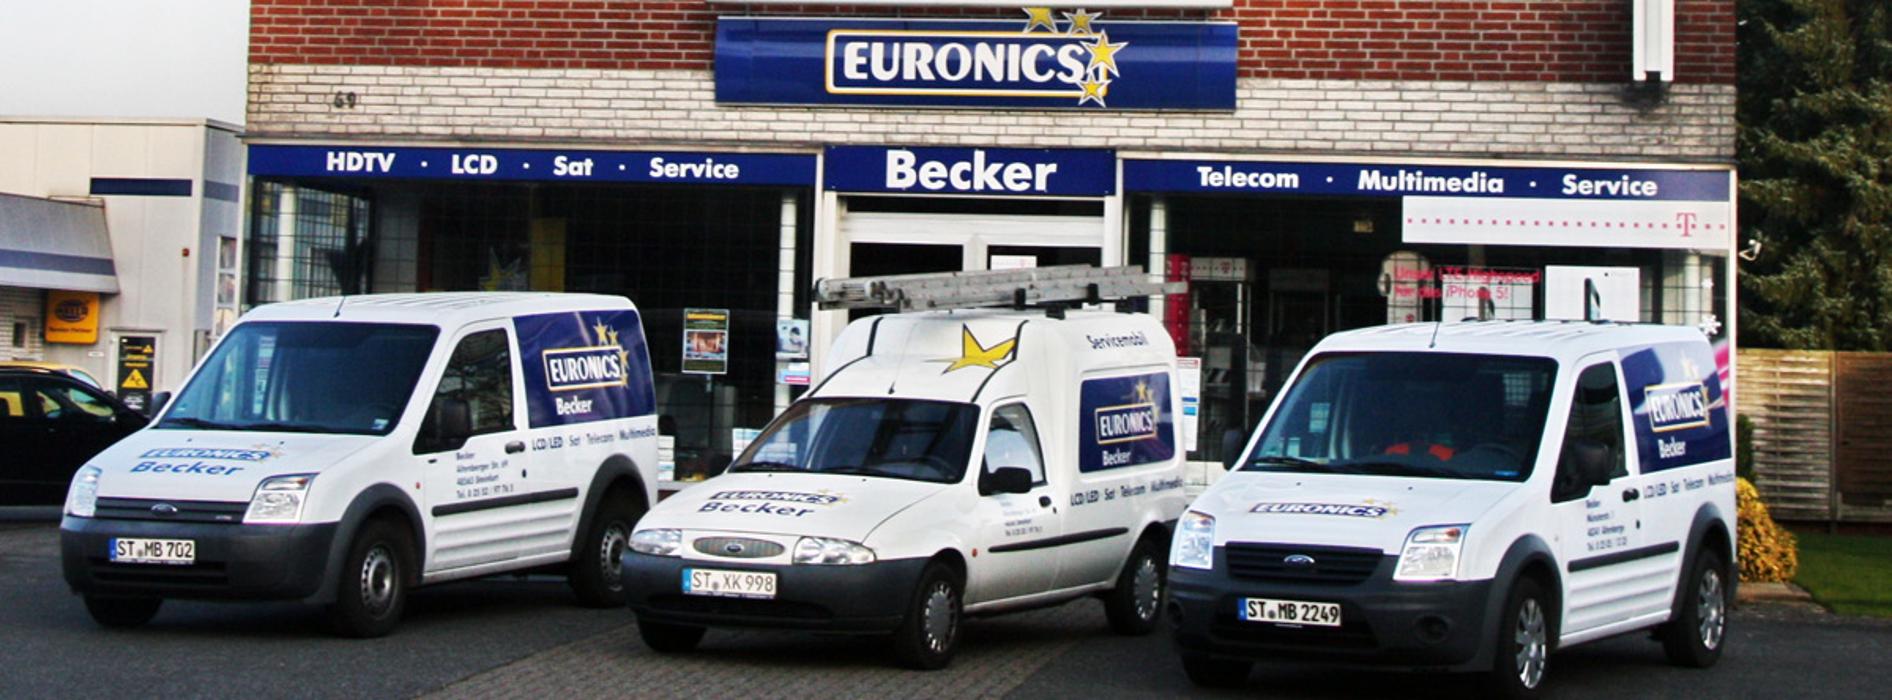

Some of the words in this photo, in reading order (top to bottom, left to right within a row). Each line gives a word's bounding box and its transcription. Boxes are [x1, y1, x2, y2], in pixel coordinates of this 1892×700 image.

[843, 41, 1087, 84] EURONICS
[334, 91, 357, 109] 69
[326, 151, 396, 173] HDTV
[451, 154, 498, 175] LCD
[552, 155, 594, 177] Sat
[649, 157, 740, 180] Service
[885, 149, 1058, 192] Becker
[1197, 165, 1299, 189] Telecom
[1357, 170, 1505, 194] Multimedia
[1561, 174, 1659, 196] Service
[1676, 212, 1697, 237] T
[1445, 284, 1491, 300] iPhone
[1496, 286, 1510, 300] 5!
[1085, 331, 1149, 349] Servicemobil
[549, 354, 621, 383] EURONICS
[555, 395, 593, 416] Becker
[1650, 390, 1705, 423] EURONICS
[1099, 411, 1153, 437] EURONICS
[1102, 448, 1131, 466] Becker
[1658, 436, 1686, 459] Becker
[130, 461, 245, 476] Becker
[698, 502, 815, 517] Becker
[1254, 502, 1383, 517] EURONICS
[117, 540, 136, 556] ST
[144, 541, 163, 557] MB
[166, 542, 193, 558] 702
[692, 572, 711, 589] ST
[722, 574, 742, 590] XK
[745, 575, 774, 592] 998
[1248, 600, 1266, 618] ST
[1278, 603, 1298, 620] MB
[1301, 604, 1339, 623] 2249
